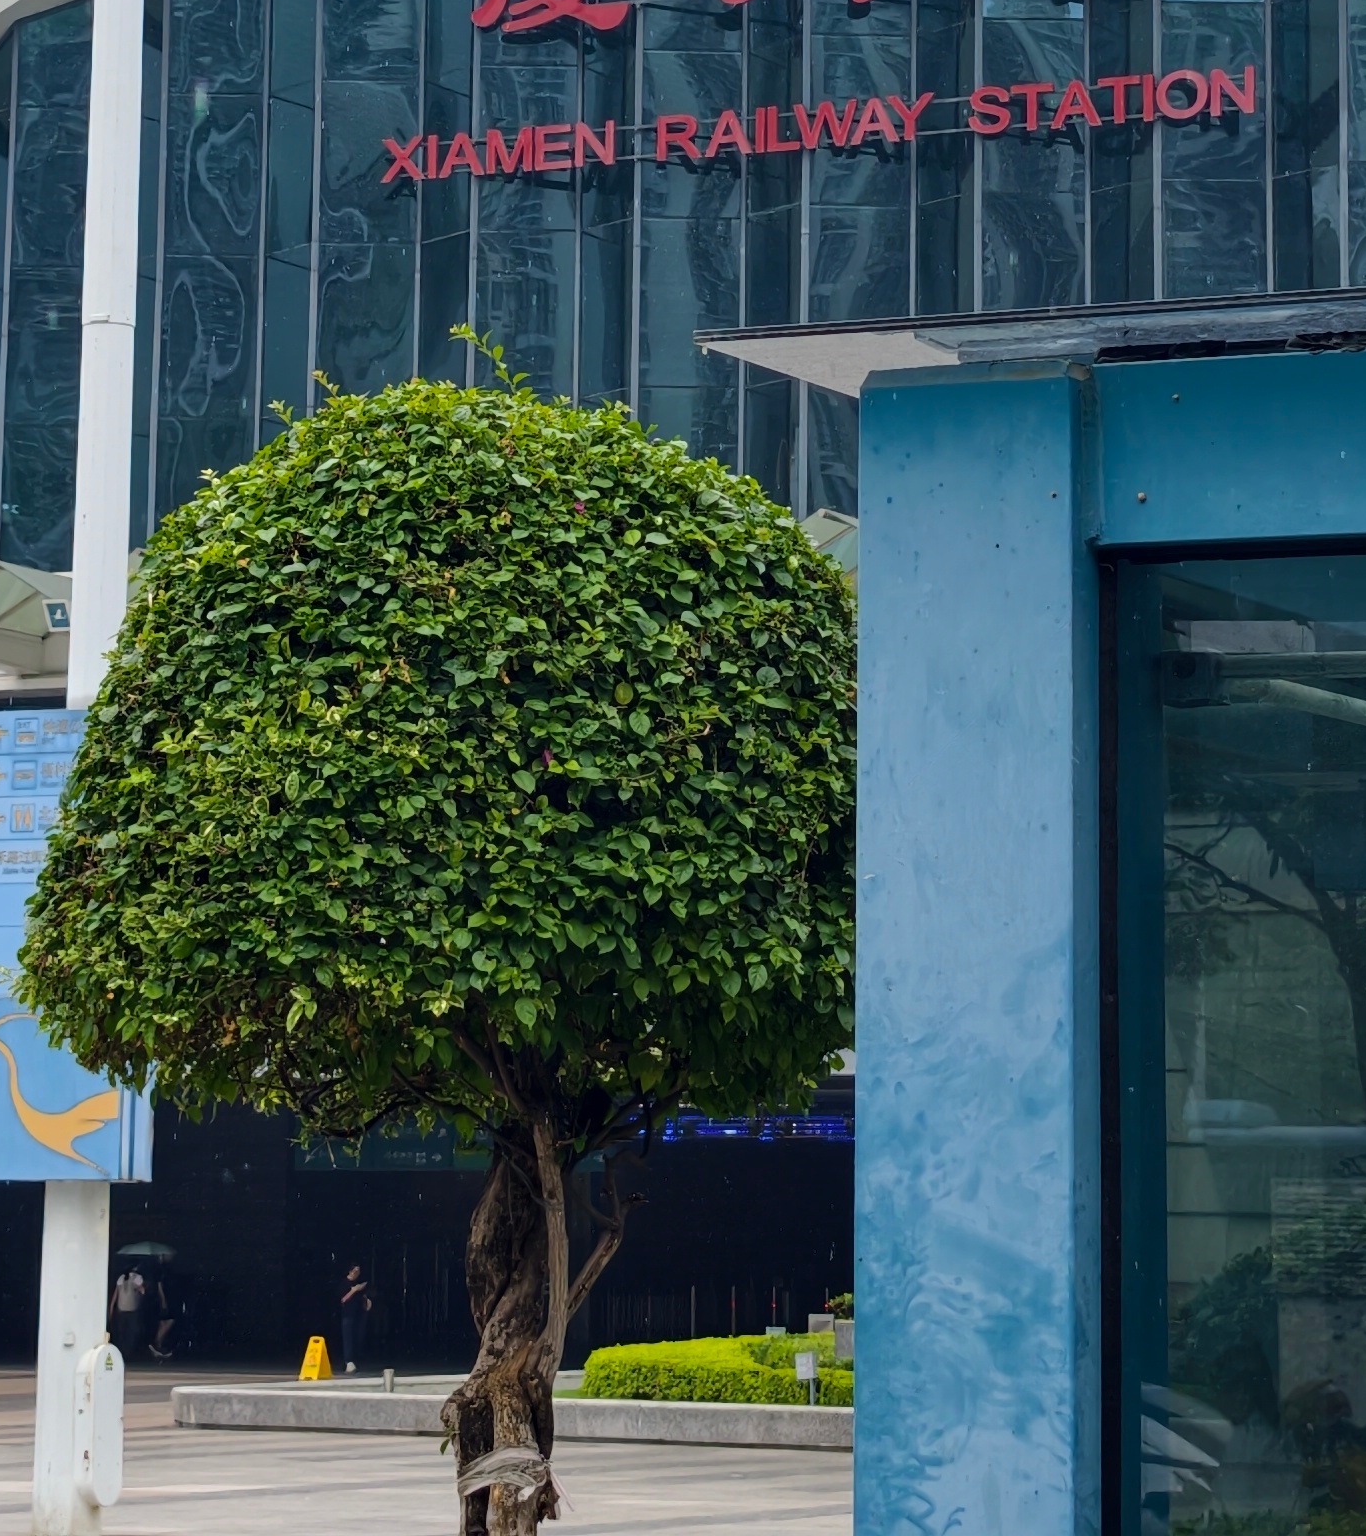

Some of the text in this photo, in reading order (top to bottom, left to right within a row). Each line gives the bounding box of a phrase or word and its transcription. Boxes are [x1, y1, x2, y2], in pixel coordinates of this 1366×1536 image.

[383, 66, 1256, 184] XIAMEN RAILWAY STATION
